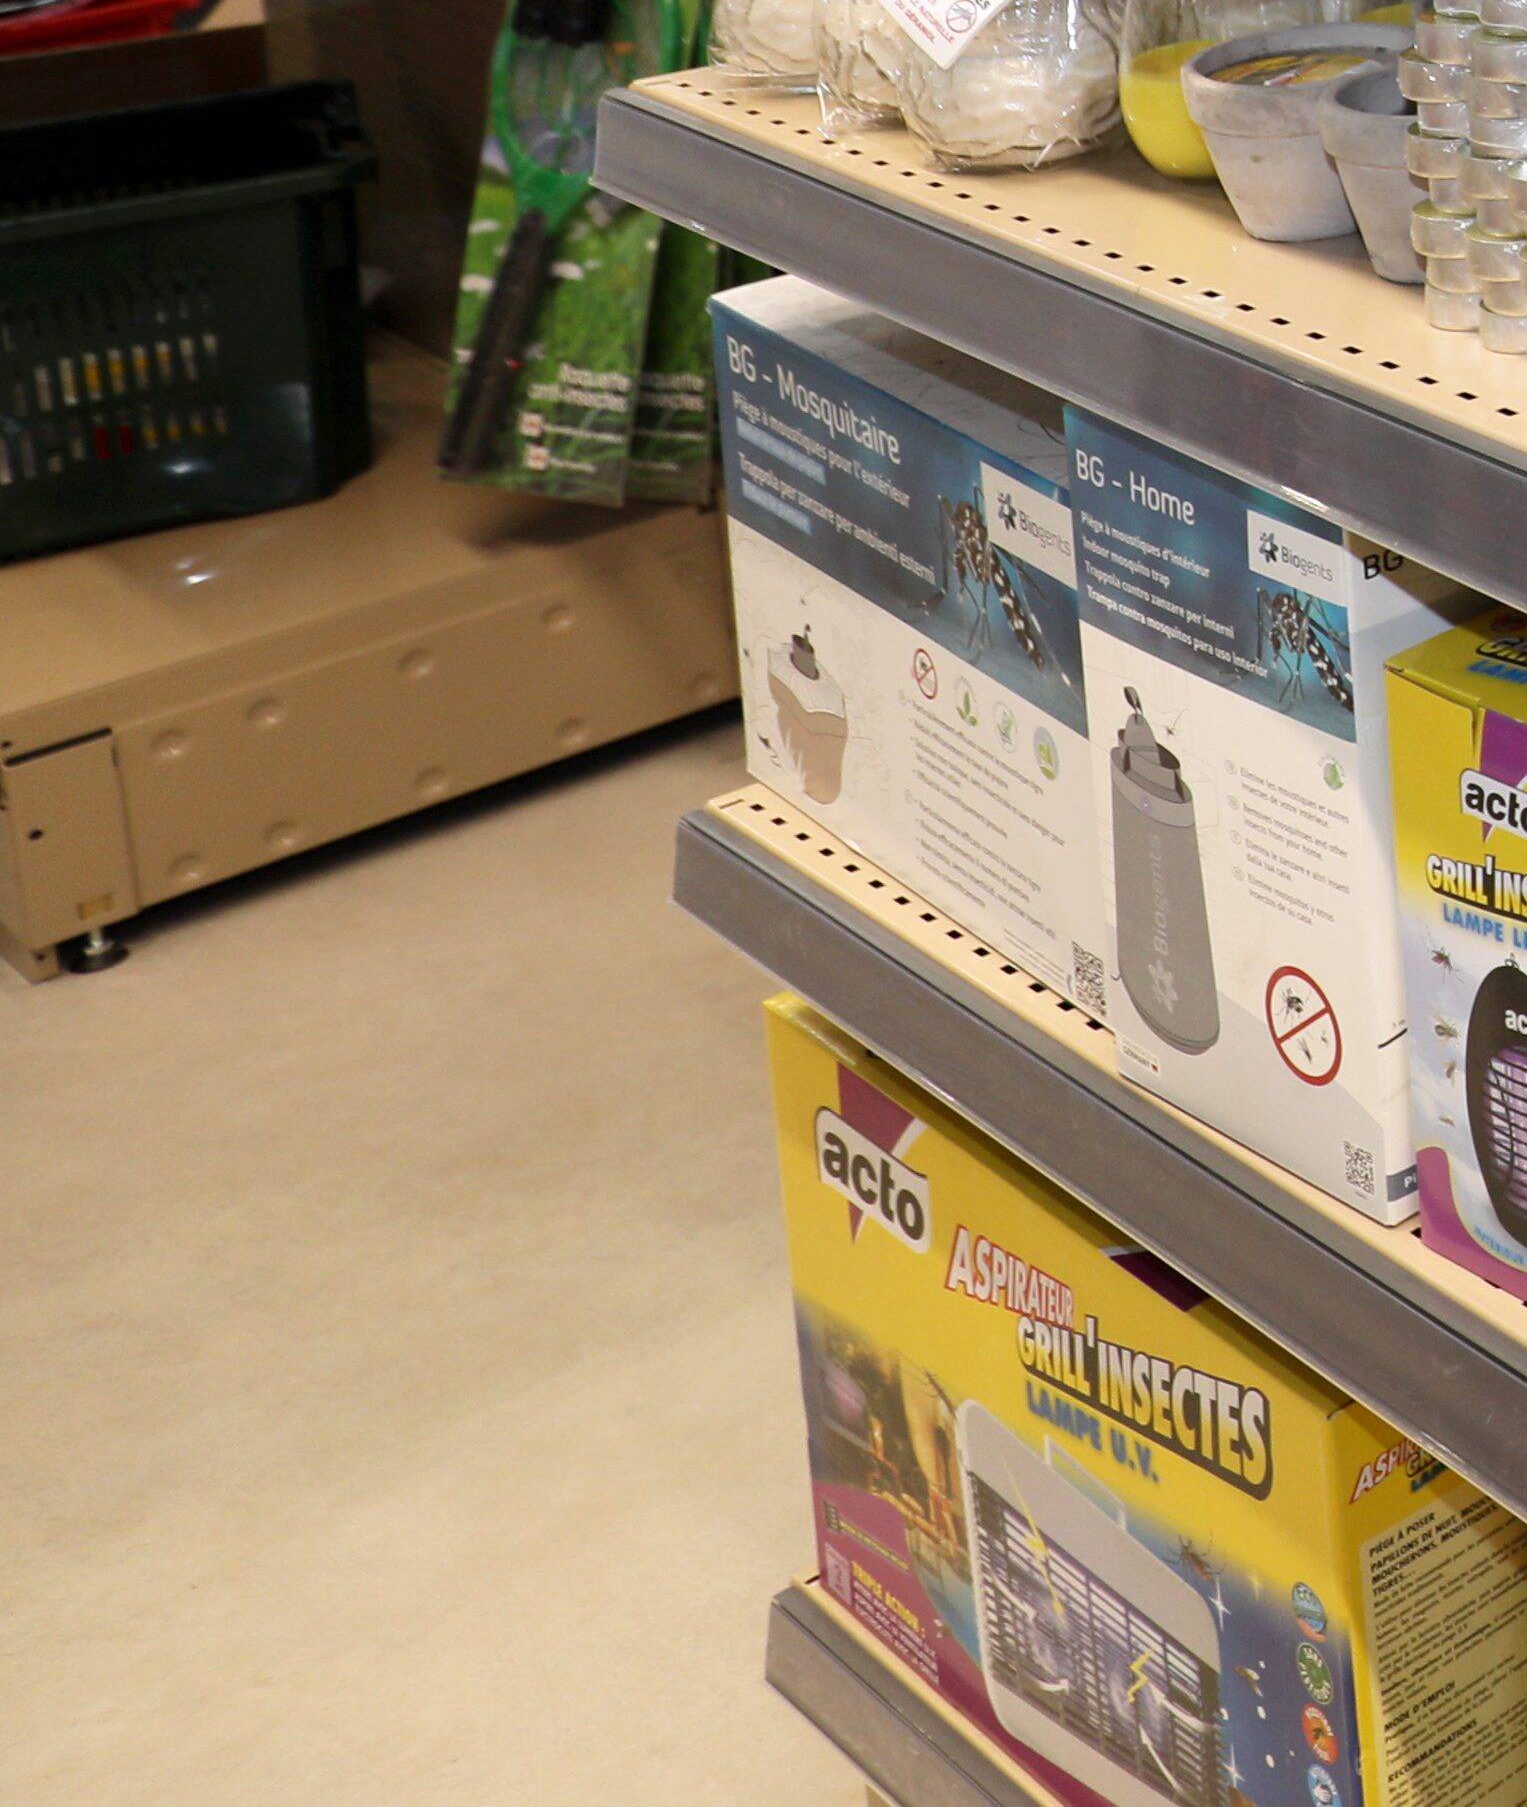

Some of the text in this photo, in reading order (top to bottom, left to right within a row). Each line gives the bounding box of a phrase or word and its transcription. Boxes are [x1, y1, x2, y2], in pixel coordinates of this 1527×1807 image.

[727, 335, 902, 466] BG Mosquitaire
[1018, 509, 1072, 558] Biogents
[1076, 449, 1196, 526] BG Home
[1281, 544, 1334, 584] Biogents
[1443, 905, 1505, 942] LAMPE
[822, 1131, 925, 1240] acto
[947, 1225, 1073, 1327] ASPIRATEUR
[1019, 1315, 1271, 1494] GRILL'INSECTES
[1027, 1380, 1161, 1485] LAMPE U.V.
